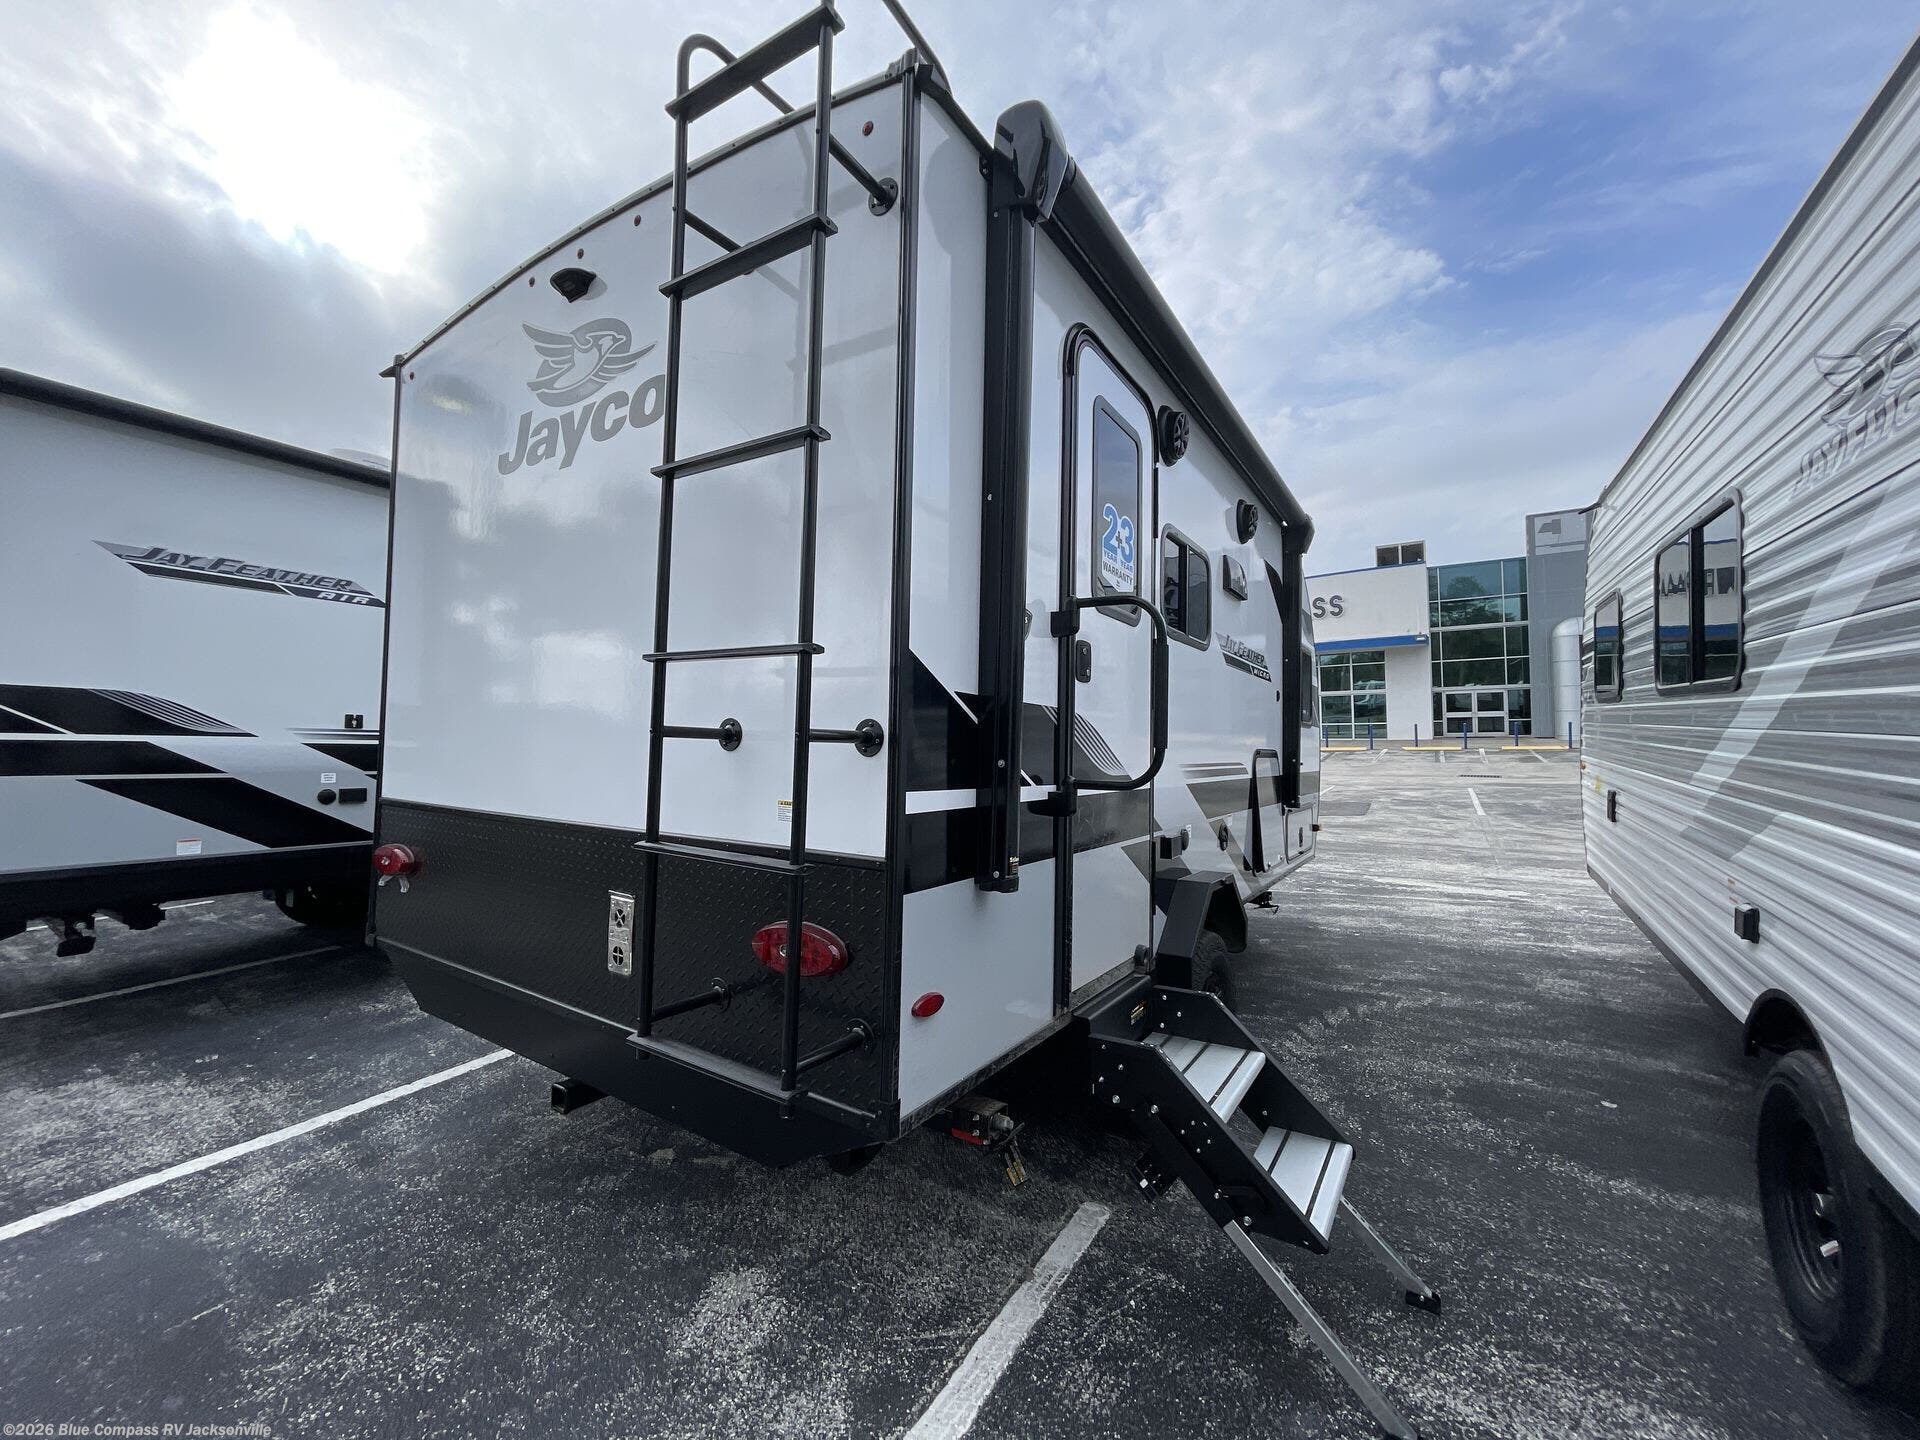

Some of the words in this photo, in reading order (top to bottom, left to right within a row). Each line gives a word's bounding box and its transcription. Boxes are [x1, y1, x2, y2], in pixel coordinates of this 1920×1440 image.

[498, 374, 665, 476] Jayco
[124, 547, 203, 569] JAY
[208, 557, 353, 591] FEATHER
[1103, 560, 1133, 586] WARRANTY
[316, 592, 370, 605] AIR
[1312, 594, 1344, 619] SS
[1236, 641, 1265, 668] FEATHER
